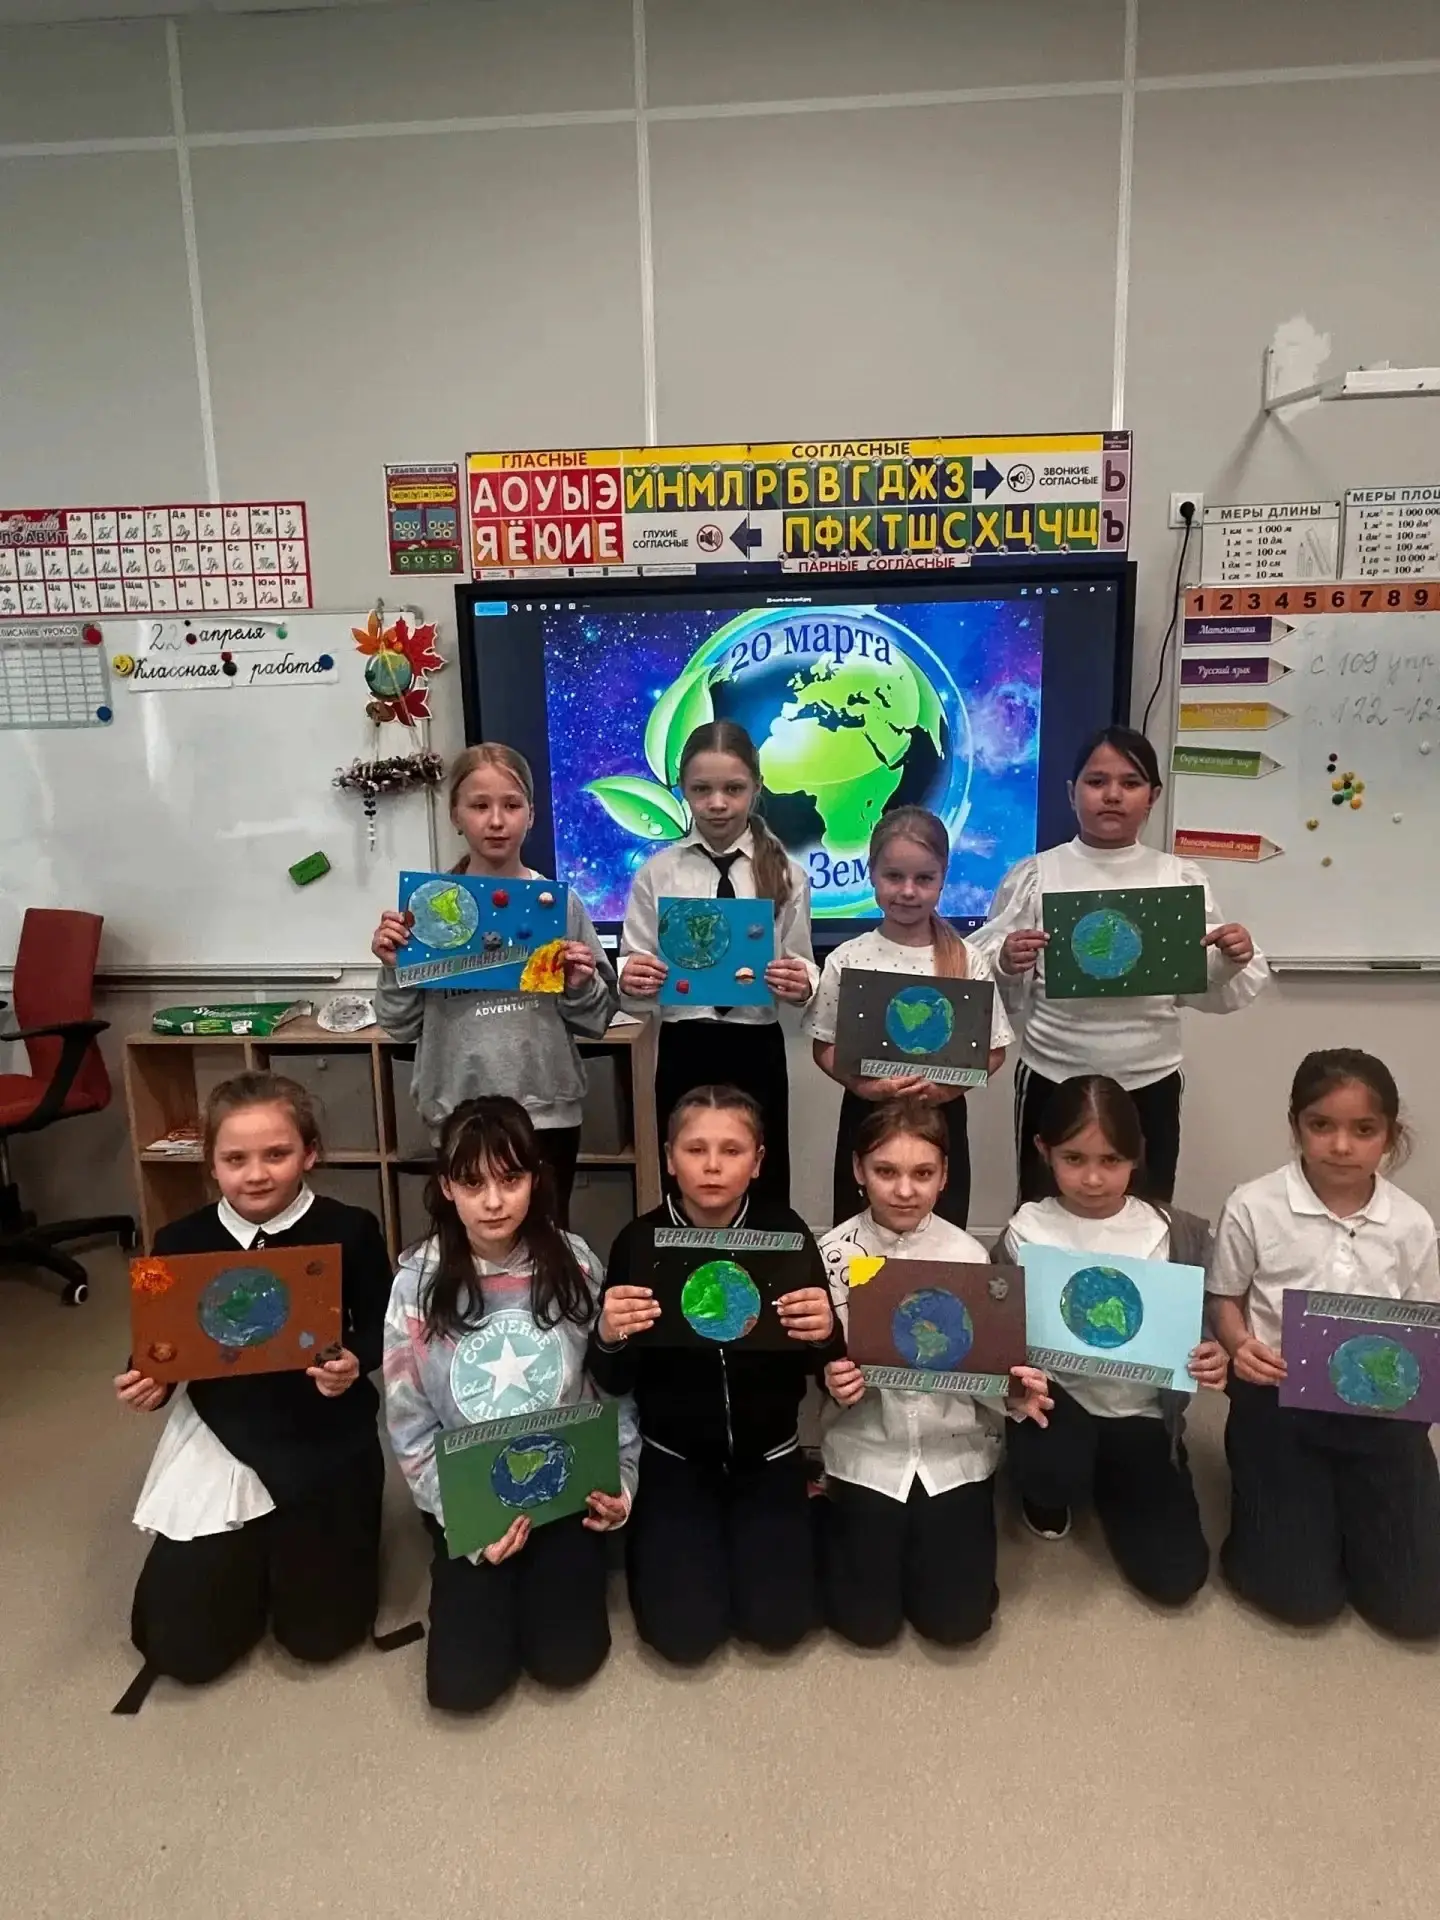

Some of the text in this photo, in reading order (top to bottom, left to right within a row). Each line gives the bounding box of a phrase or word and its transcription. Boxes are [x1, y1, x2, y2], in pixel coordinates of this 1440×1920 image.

[791, 442, 911, 458] СОГЛАСНЫЕ
[501, 452, 588, 469] ГЛАСНЫЕ
[1043, 466, 1090, 477] ЗВОНКИЕ
[1039, 475, 1098, 487] СОГЛАСНЫЕ
[1353, 491, 1396, 502] МЕРЫ
[1221, 506, 1321, 519] МЕРЫ ДЛИНЫ
[1398, 520, 1414, 528] 100
[0, 530, 68, 545] ЛФАВИТ
[643, 529, 678, 539] ГЛУХИЕ
[1258, 537, 1268, 545] 10
[1397, 532, 1413, 540] 100
[632, 537, 689, 549] СОГЛАСНЫЕ
[1397, 543, 1413, 551] 100
[1257, 548, 1273, 556] 100
[799, 557, 956, 573] ПАРНЫЕ СОГЛАСНЫЕ
[1395, 566, 1411, 574] 100
[1256, 571, 1267, 579] 10
[1193, 589, 1429, 611] 1 2 3 4 5 6 7 8 9
[43, 626, 78, 636] УРОКОВ
[1198, 624, 1256, 635] Математика
[200, 627, 266, 649] апреля
[731, 623, 892, 673] 20 марта
[134, 653, 323, 683] Классная работа
[1198, 665, 1250, 678] Русский язык
[400, 960, 454, 981] БЕРЕГИТЕ
[475, 999, 540, 1016] ADVENTUS
[862, 1062, 915, 1077] БЕРЕГИТЕ
[656, 1231, 717, 1245] БЕРЕГИТЕ
[725, 1231, 785, 1248] ПЛАНЕТУ
[463, 1320, 551, 1364] CONVERSE
[1028, 1350, 1088, 1371] БЕРЕГИТЕ
[864, 1368, 925, 1387] БЕРЕГИТЕ
[510, 1390, 549, 1416] STAR
[451, 1422, 511, 1447] БЕРЕГИТЕ
